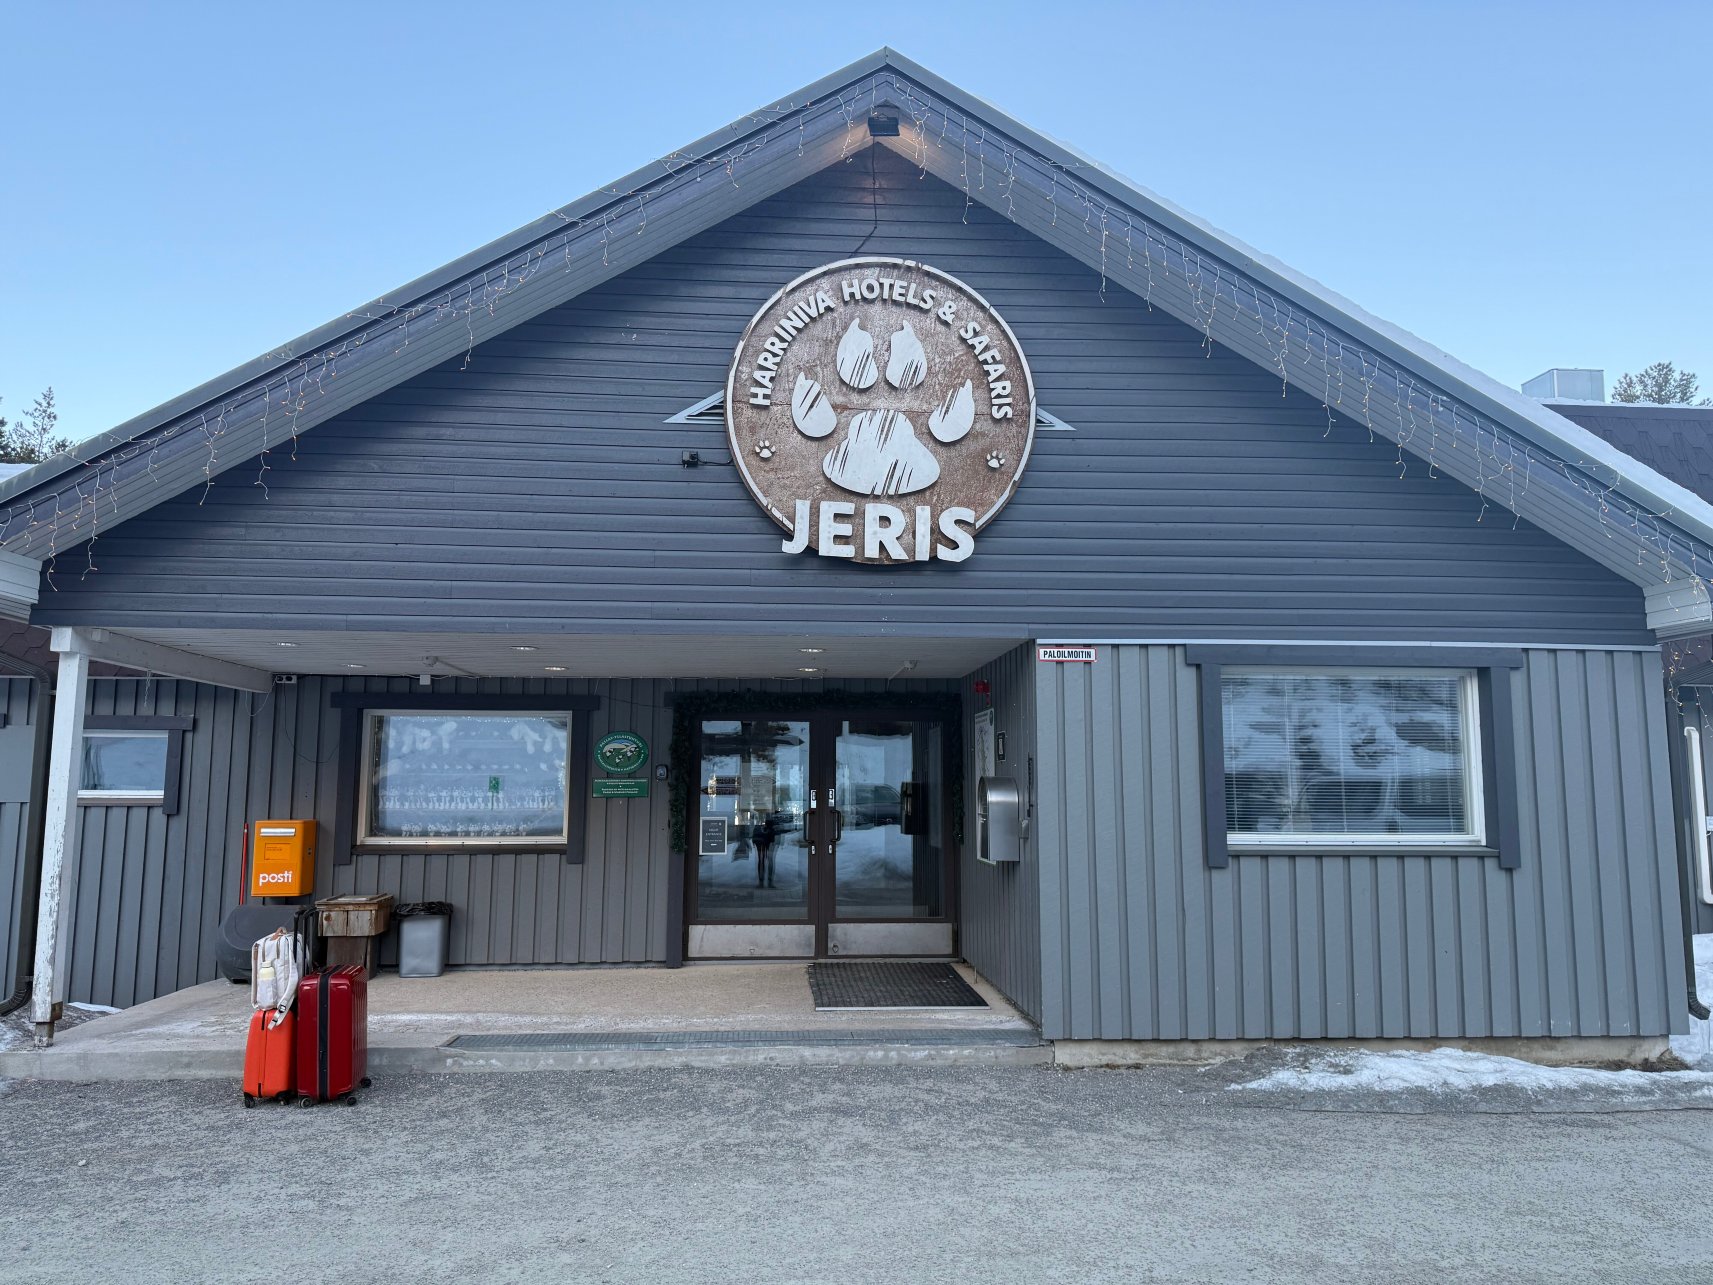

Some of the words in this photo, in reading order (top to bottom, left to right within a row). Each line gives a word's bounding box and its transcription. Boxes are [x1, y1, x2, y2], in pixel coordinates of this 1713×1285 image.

[749, 290, 836, 407] HARRINIVA
[841, 278, 937, 310] HOTELS
[937, 301, 958, 325] &
[959, 321, 1013, 420] SAFARIS
[781, 499, 976, 563] JERIS
[1043, 650, 1092, 659] PALOILMOITIN
[259, 870, 293, 887] posti
